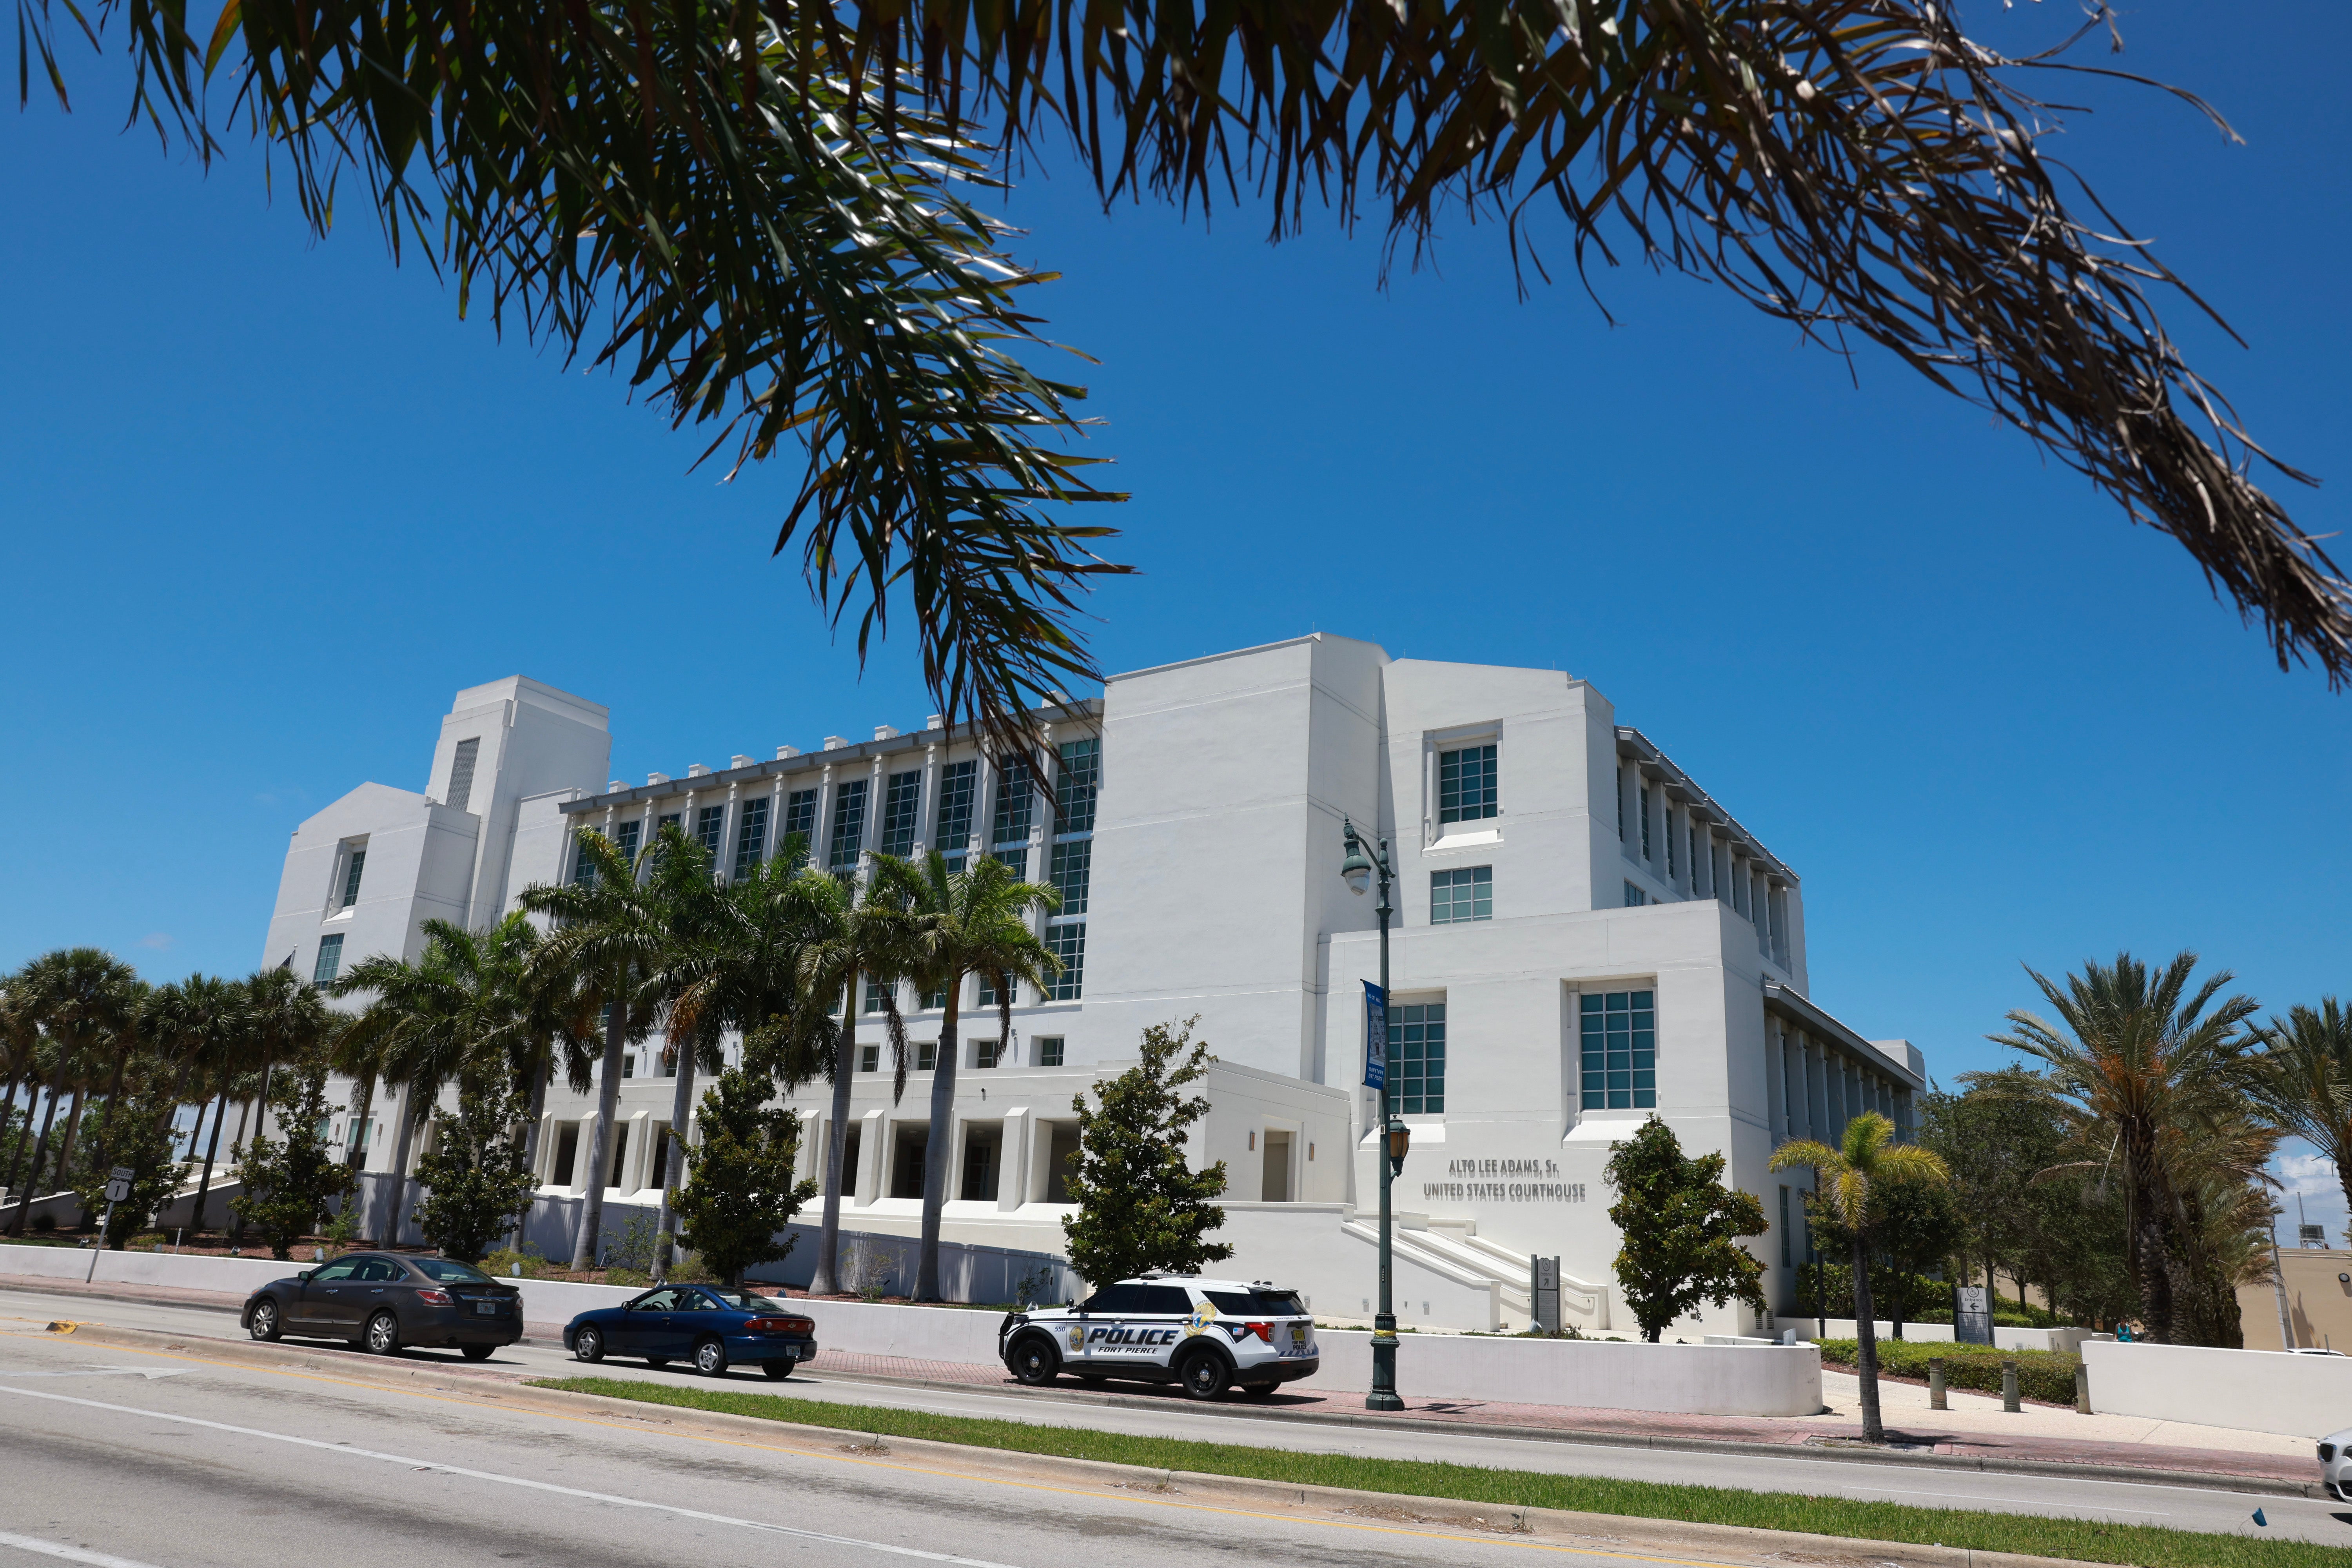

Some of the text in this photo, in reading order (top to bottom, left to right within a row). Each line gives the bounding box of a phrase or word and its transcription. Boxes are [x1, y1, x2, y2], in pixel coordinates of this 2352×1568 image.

[113, 1169, 132, 1178] SOUTH
[1449, 1160, 1559, 1175] ALTO LEE ADAMS, Sr.
[115, 1185, 120, 1197] 1
[1424, 1183, 1585, 1197] UNITED STATES COURTHOUSE
[1087, 1328, 1180, 1345] POLICE
